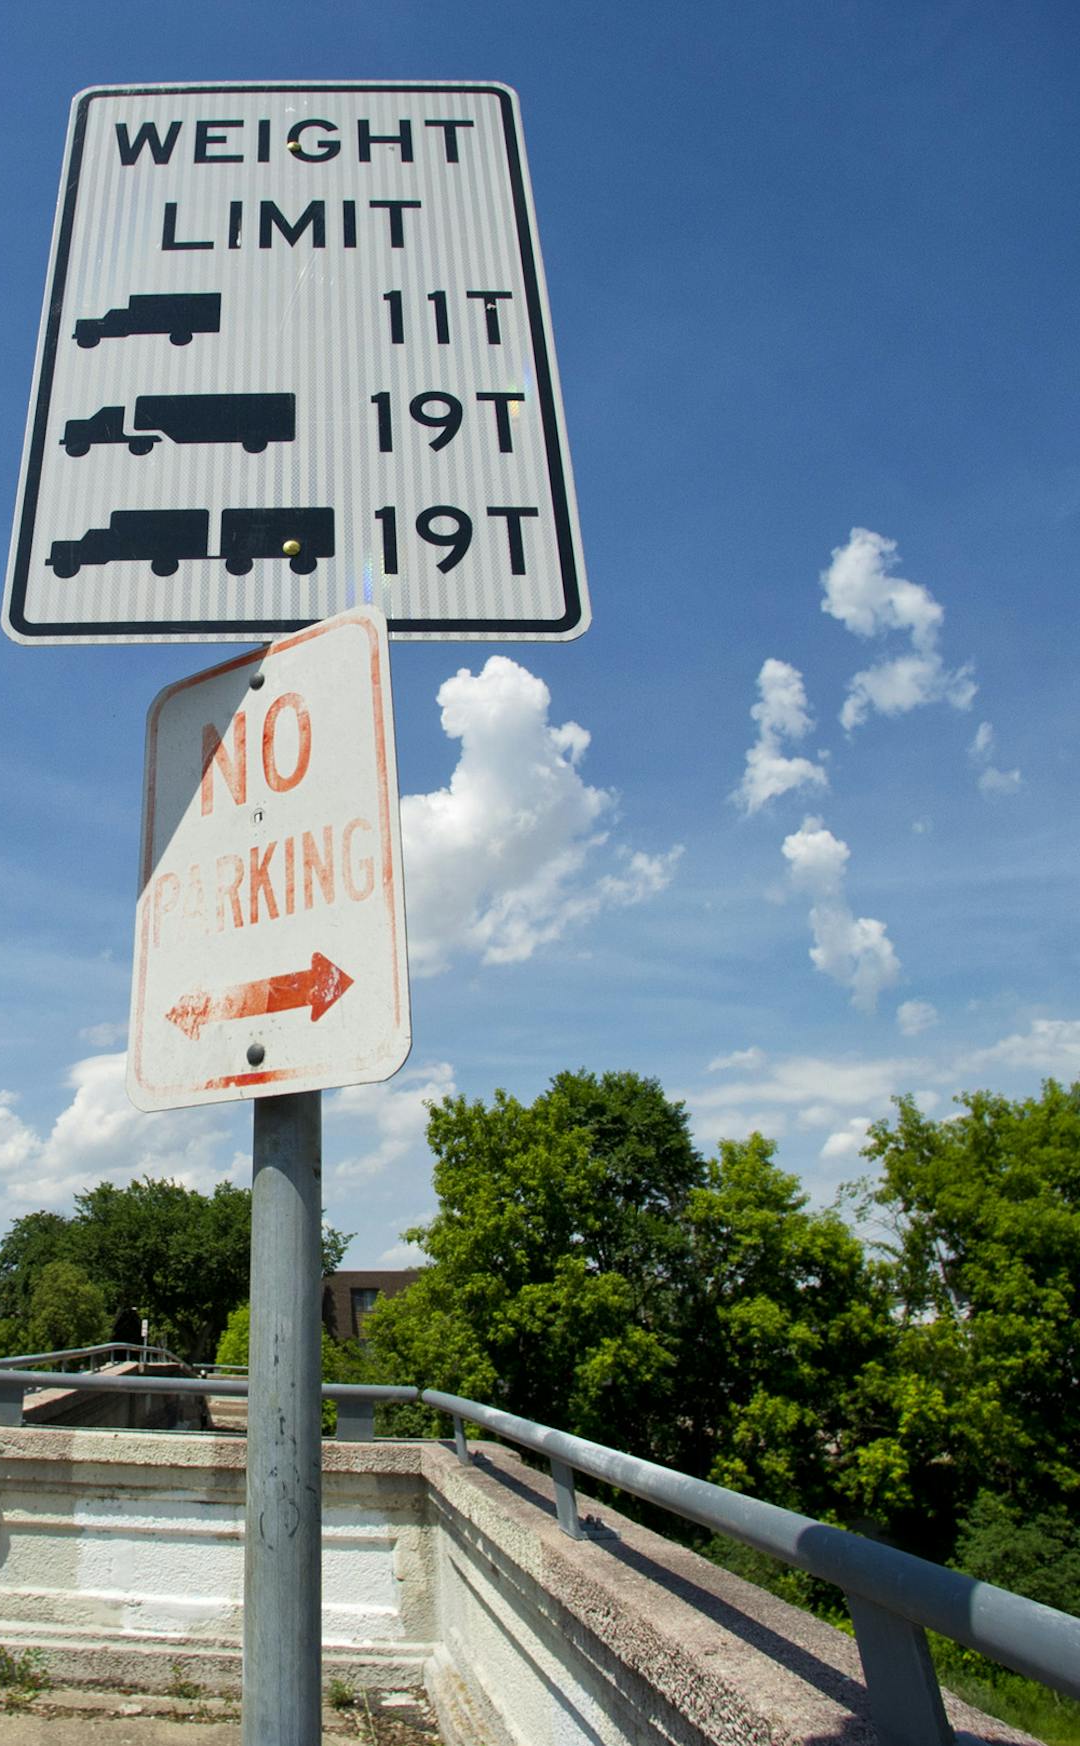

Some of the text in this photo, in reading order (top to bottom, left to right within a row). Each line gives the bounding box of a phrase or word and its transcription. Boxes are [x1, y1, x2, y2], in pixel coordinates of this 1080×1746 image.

[115, 119, 474, 165] WEIGHT
[161, 200, 421, 250] LIMIT
[383, 290, 513, 345] 11T
[370, 391, 525, 453] 19T
[375, 505, 539, 575] 19T
[201, 692, 312, 816] NO
[153, 818, 375, 949] PARKING
